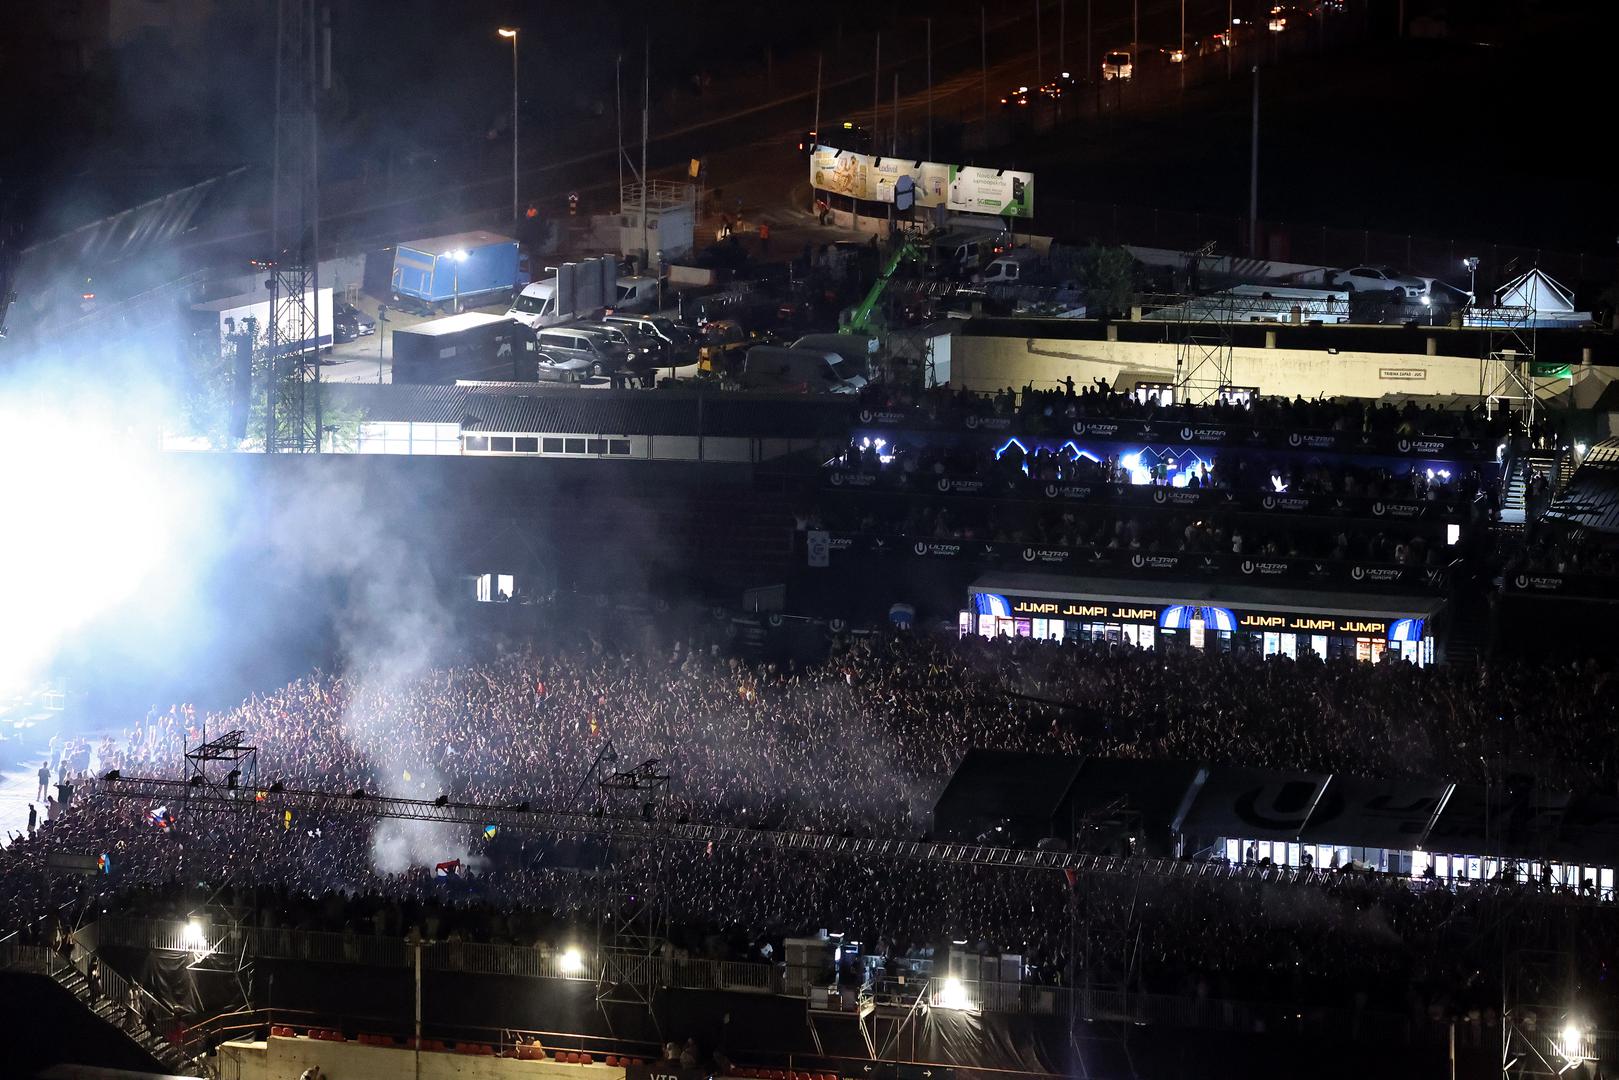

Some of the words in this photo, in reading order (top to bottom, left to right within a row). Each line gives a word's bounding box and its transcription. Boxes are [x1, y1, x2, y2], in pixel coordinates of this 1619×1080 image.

[1014, 602, 1058, 614] JUMP!
[1063, 606, 1107, 617] JUMP!
[1112, 608, 1156, 620] JUMP!
[1240, 615, 1285, 627] JUMP!
[1290, 618, 1335, 630] JUMP!
[1340, 622, 1385, 633] JUMP!
